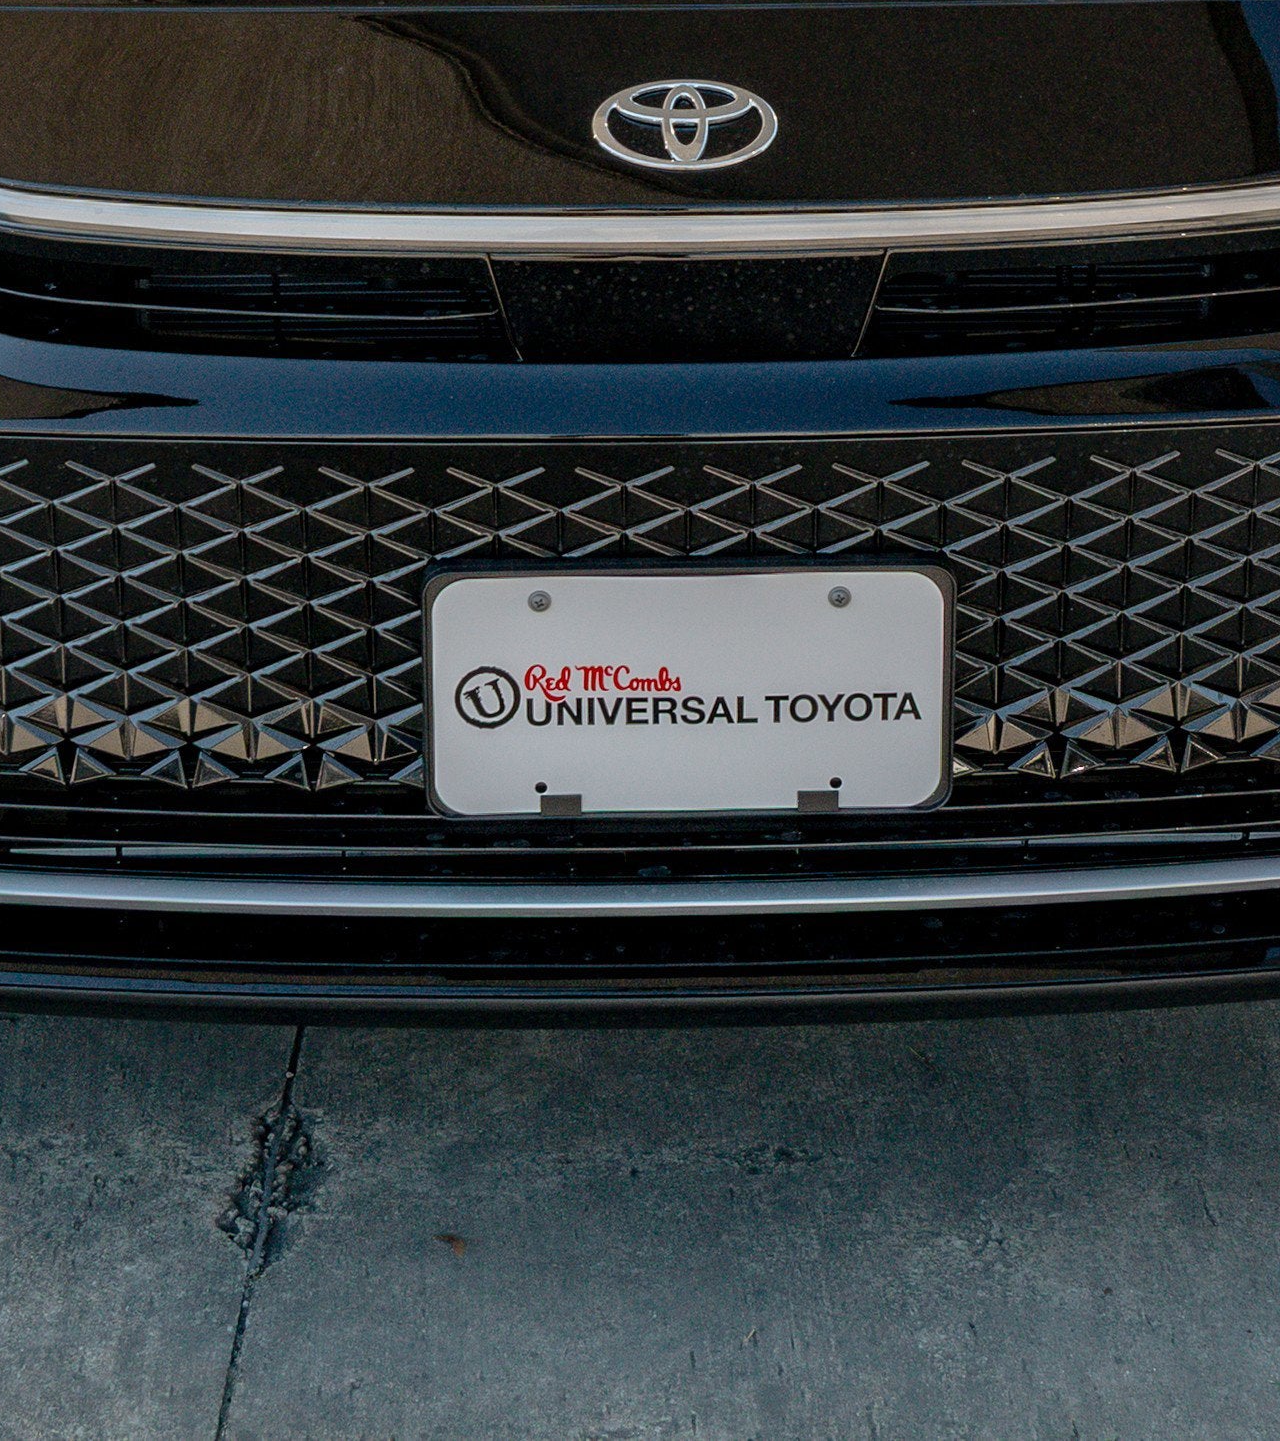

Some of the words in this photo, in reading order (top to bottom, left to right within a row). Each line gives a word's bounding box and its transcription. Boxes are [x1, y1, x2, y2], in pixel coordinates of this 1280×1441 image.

[524, 664, 570, 702] Red
[575, 665, 682, 693] McCombs
[525, 694, 758, 727] UNIVERSAL
[765, 692, 923, 724] TOYOTA
